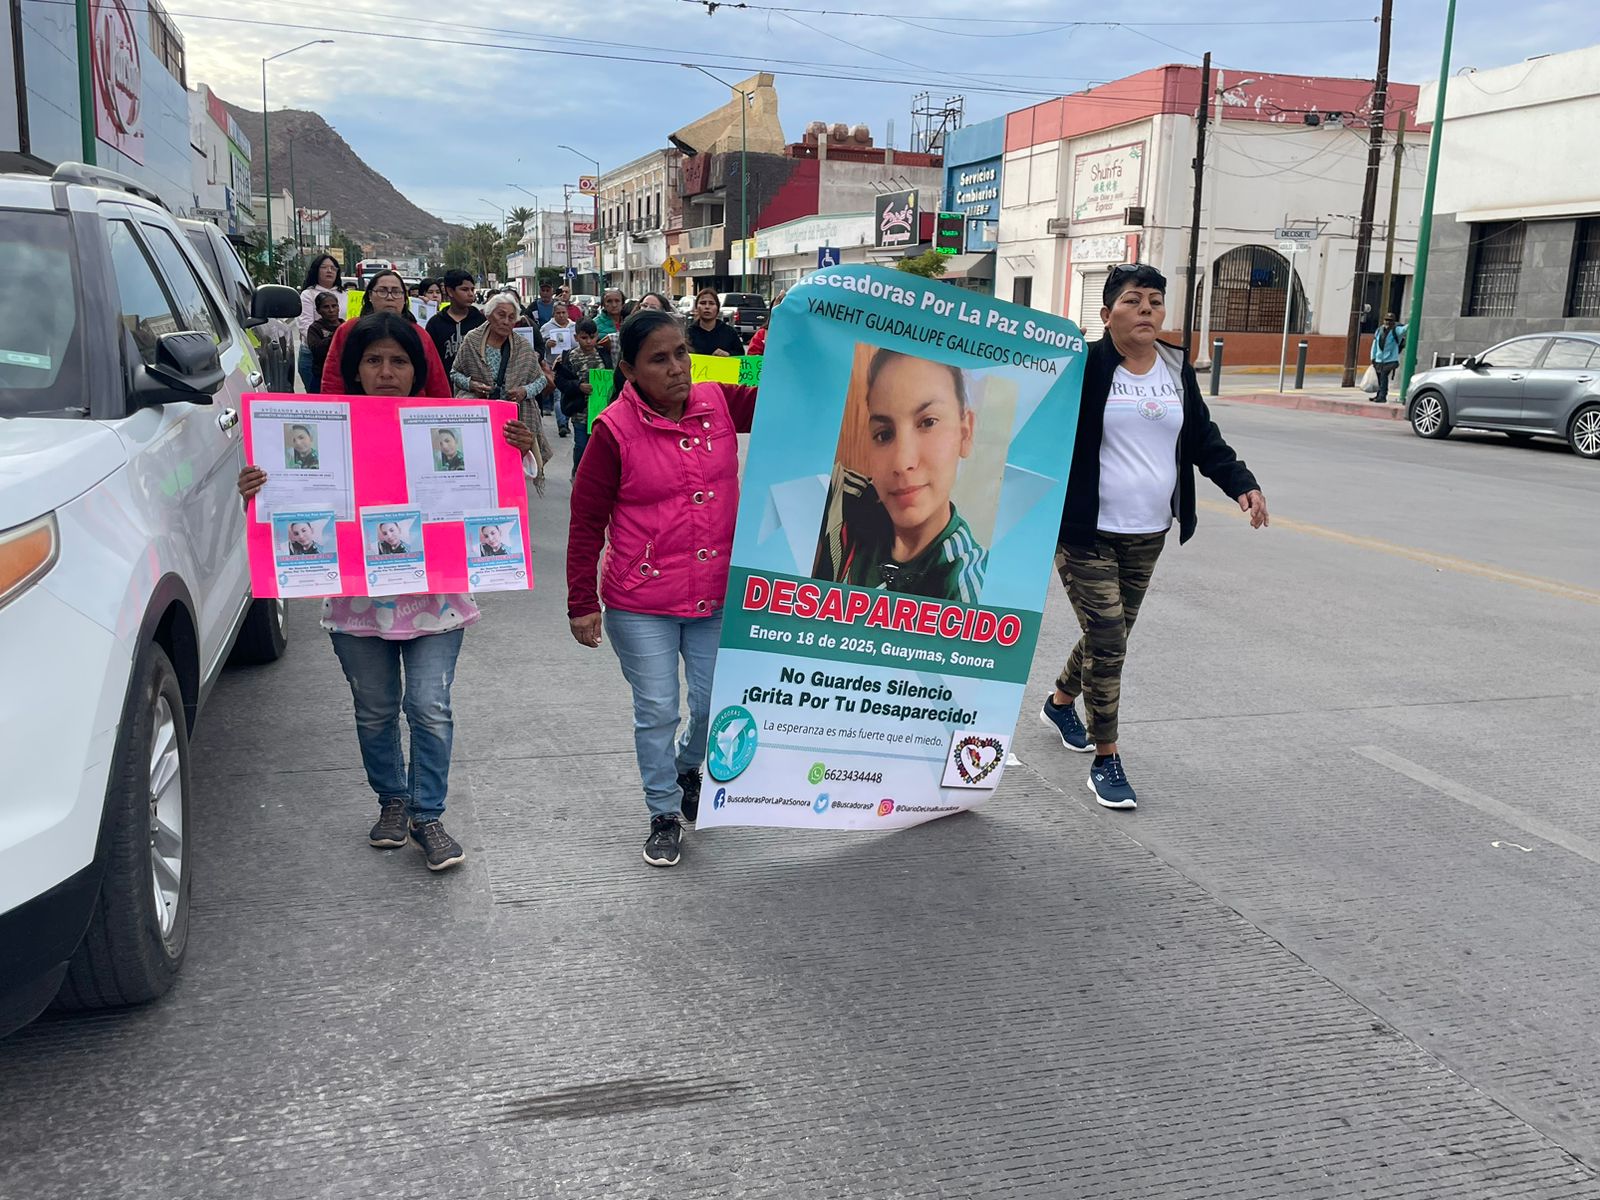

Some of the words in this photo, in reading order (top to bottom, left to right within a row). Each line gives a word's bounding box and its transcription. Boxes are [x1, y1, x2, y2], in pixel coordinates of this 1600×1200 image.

[960, 167, 995, 186] Servicios
[957, 185, 998, 204] Cambiarios
[1281, 230, 1311, 238] DIECISIETE
[920, 291, 955, 317] Por
[958, 301, 982, 326] La
[986, 309, 1017, 335] Paz
[1022, 320, 1084, 353] Sonora
[807, 297, 864, 325] YANEHT
[865, 313, 946, 347] GUADALUPE
[946, 335, 1010, 364] GALLEGOS
[1012, 351, 1057, 375] OCHOA
[1111, 382, 1146, 397] RUE
[743, 575, 1022, 646] DESAPARECIDO
[749, 625, 792, 643] Enero
[796, 631, 815, 646] 18
[818, 632, 837, 648] de
[840, 637, 878, 656] 2025,
[880, 642, 946, 665] Guaymas,
[949, 651, 996, 669] Sonora
[780, 667, 805, 684] No
[811, 671, 882, 694] Guardes
[886, 680, 953, 702] Silencio
[742, 686, 793, 707] ¡Grita
[798, 691, 830, 710] Por
[834, 696, 856, 713] Tu
[860, 700, 978, 726] Desaparecido!
[763, 720, 775, 732] La
[777, 722, 824, 740] esperanza
[826, 728, 837, 738] es
[838, 727, 857, 740] más
[858, 728, 886, 743] fuerte
[887, 732, 903, 745] que
[905, 731, 913, 744] el
[914, 732, 944, 747] miedo.
[824, 769, 883, 784] 6623434448
[727, 795, 811, 807] BuscadorasPorLaPazSonora
[831, 800, 874, 810] @BuscadorasP
